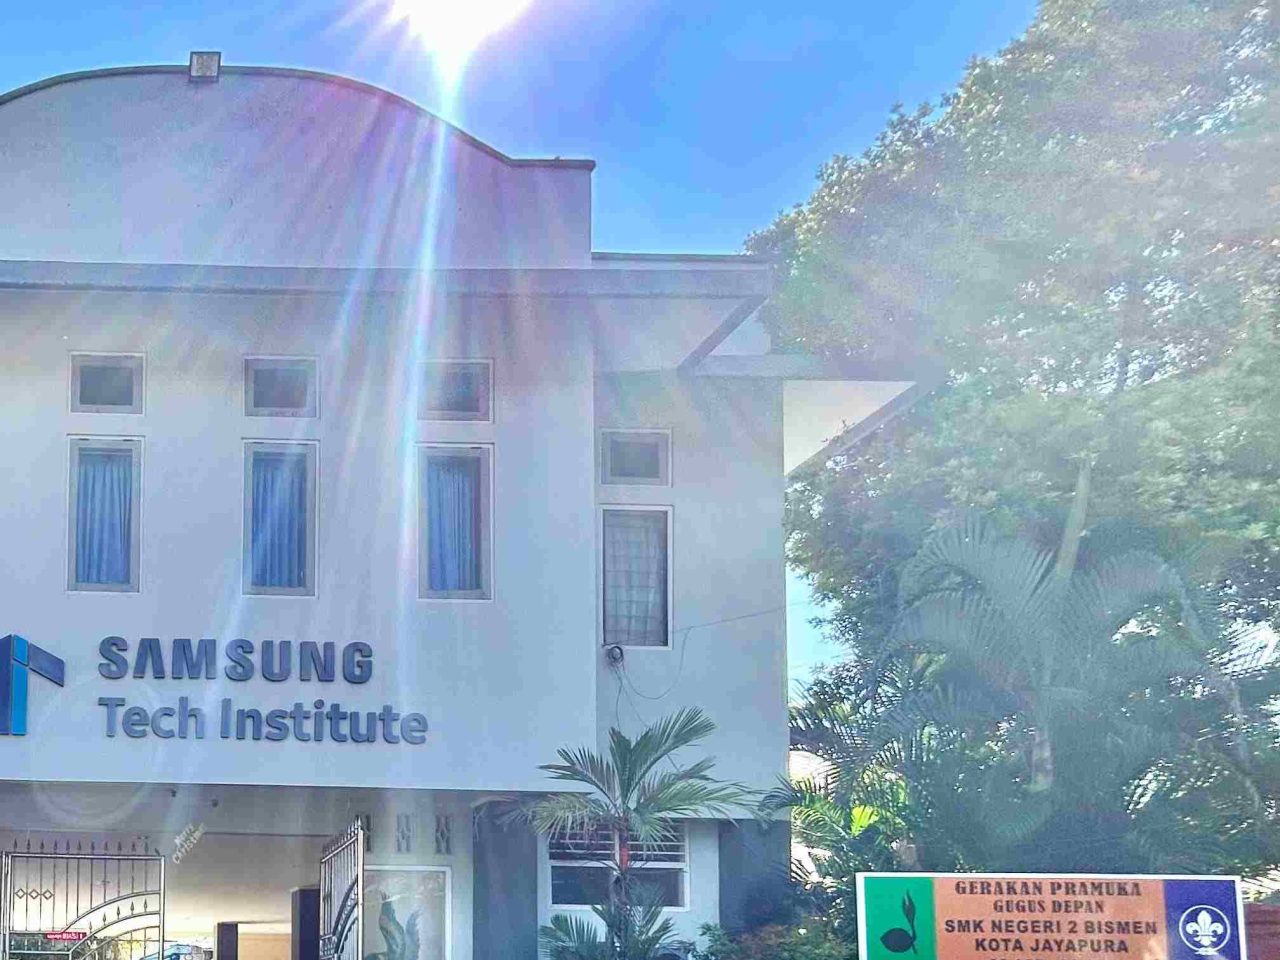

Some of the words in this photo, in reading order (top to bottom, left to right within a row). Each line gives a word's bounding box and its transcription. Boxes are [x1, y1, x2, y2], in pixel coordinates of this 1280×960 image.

[98, 636, 374, 683] SAMSUNG
[98, 697, 204, 739] Tech
[220, 699, 429, 744] Institute
[955, 880, 1043, 895] GERAKAN
[1050, 881, 1142, 896] PRAMUKA
[993, 899, 1046, 913] GUGUS
[1051, 900, 1104, 913] DEPAN
[944, 919, 985, 933] SMK
[991, 919, 1061, 933] NEGERI
[1067, 920, 1079, 933] 2
[1084, 920, 1157, 934] BISMEN
[975, 938, 1024, 952] KOTA
[1030, 938, 1128, 953] JAYAPURA
